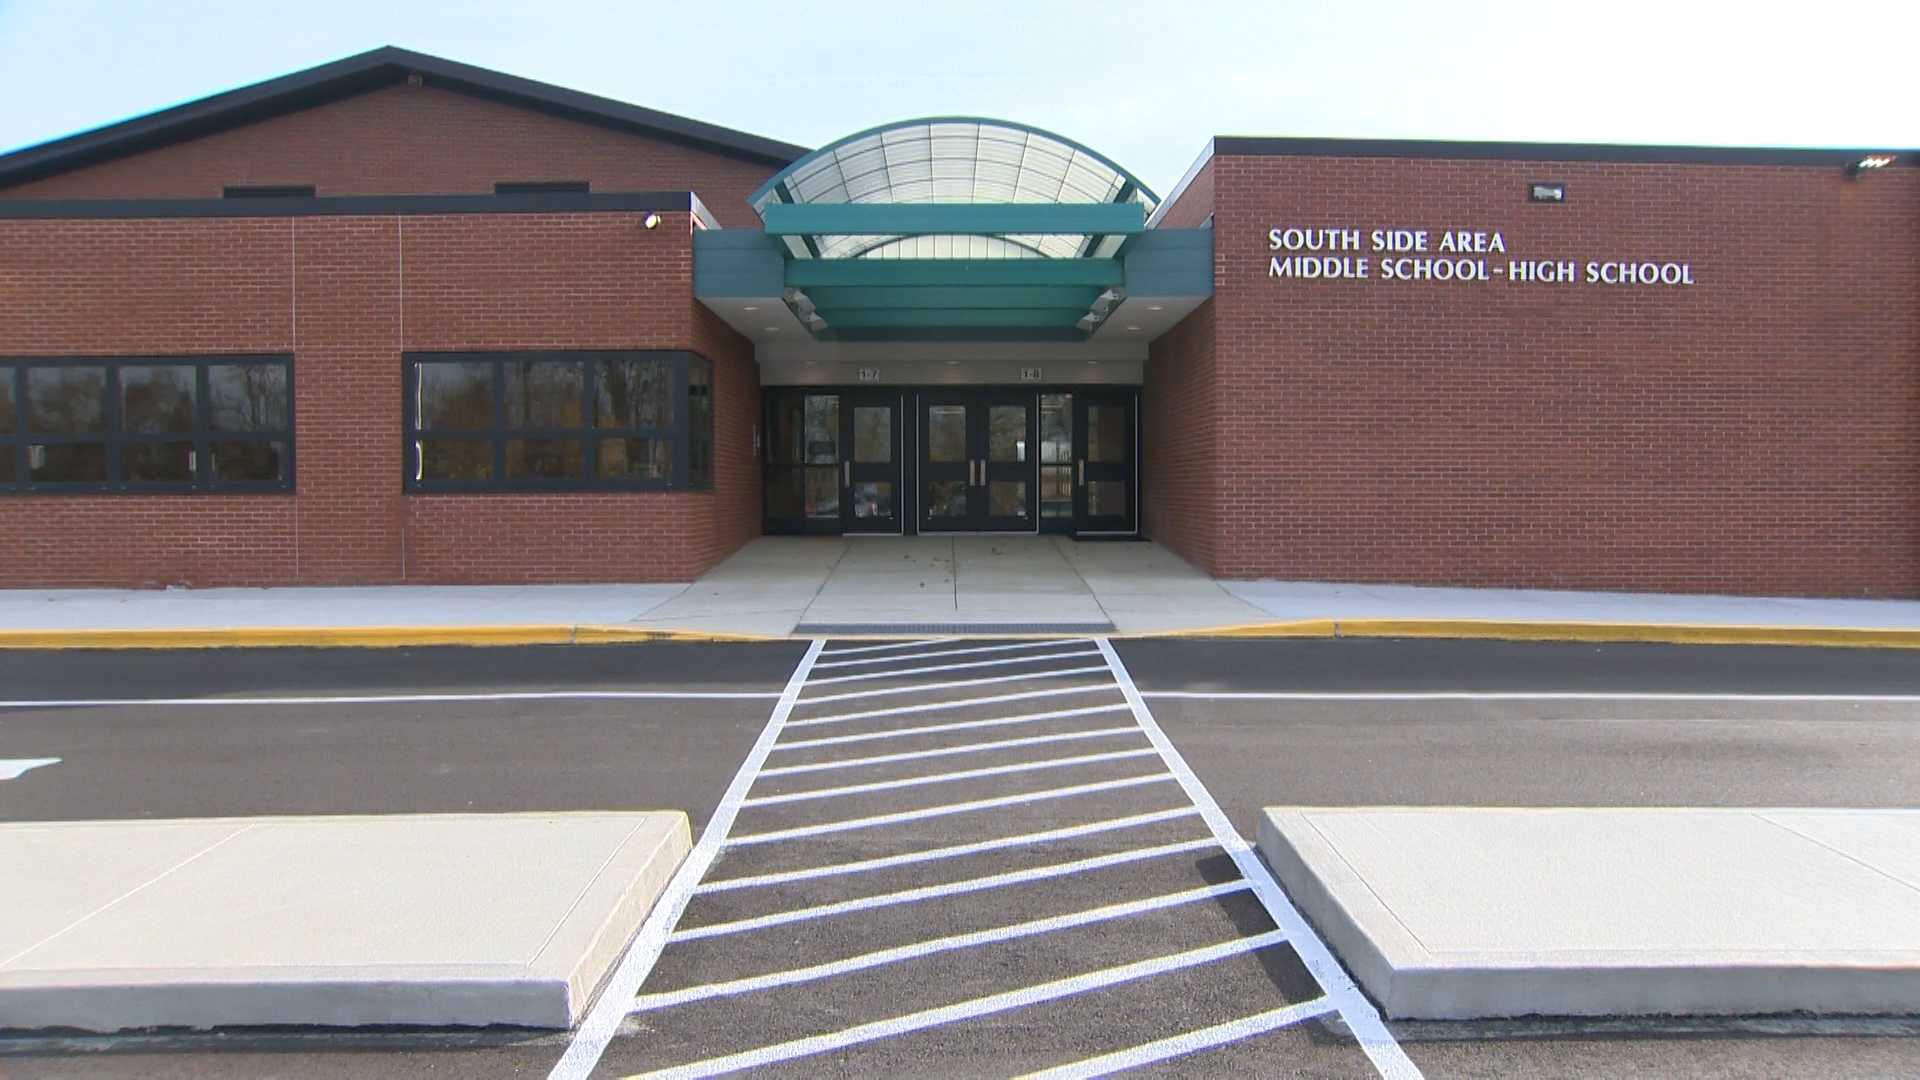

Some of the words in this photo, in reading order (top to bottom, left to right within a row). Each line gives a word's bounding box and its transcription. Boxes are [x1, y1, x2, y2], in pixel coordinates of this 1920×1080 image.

[1268, 228, 1361, 251] SOUTH
[1371, 229, 1428, 252] SIDE
[1437, 231, 1505, 253] AREA
[1268, 256, 1369, 279] MIDDLE
[1585, 262, 1694, 285] SCHOOL
